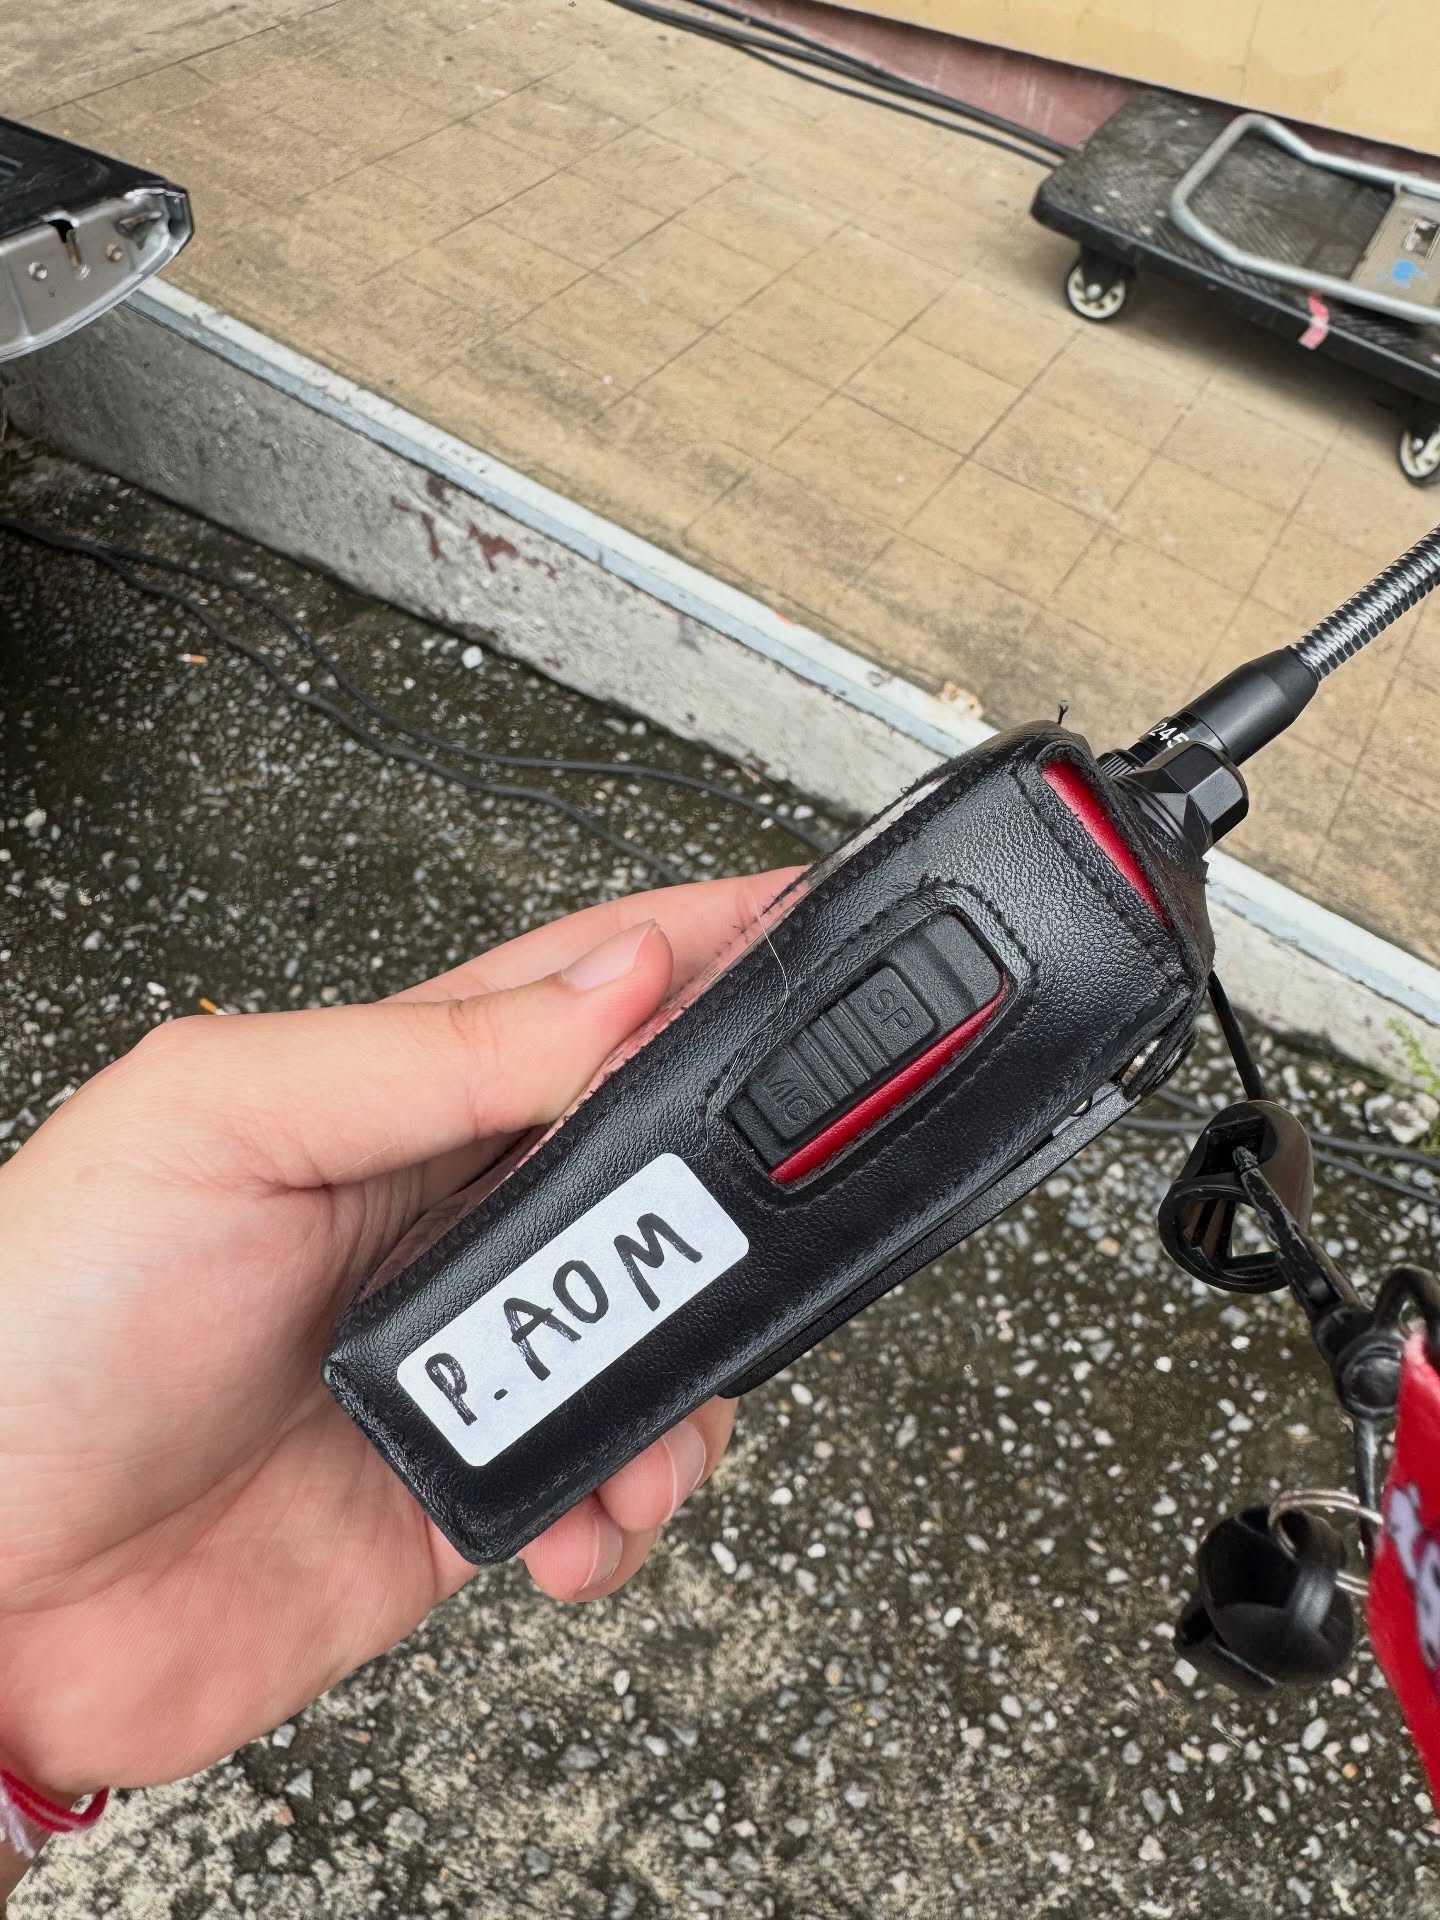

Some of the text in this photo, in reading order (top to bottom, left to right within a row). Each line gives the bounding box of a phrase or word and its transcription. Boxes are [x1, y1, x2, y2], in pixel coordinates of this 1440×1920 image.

[1148, 721, 1190, 749] 245
[867, 988, 913, 1030] SP
[756, 1061, 811, 1121] MIC
